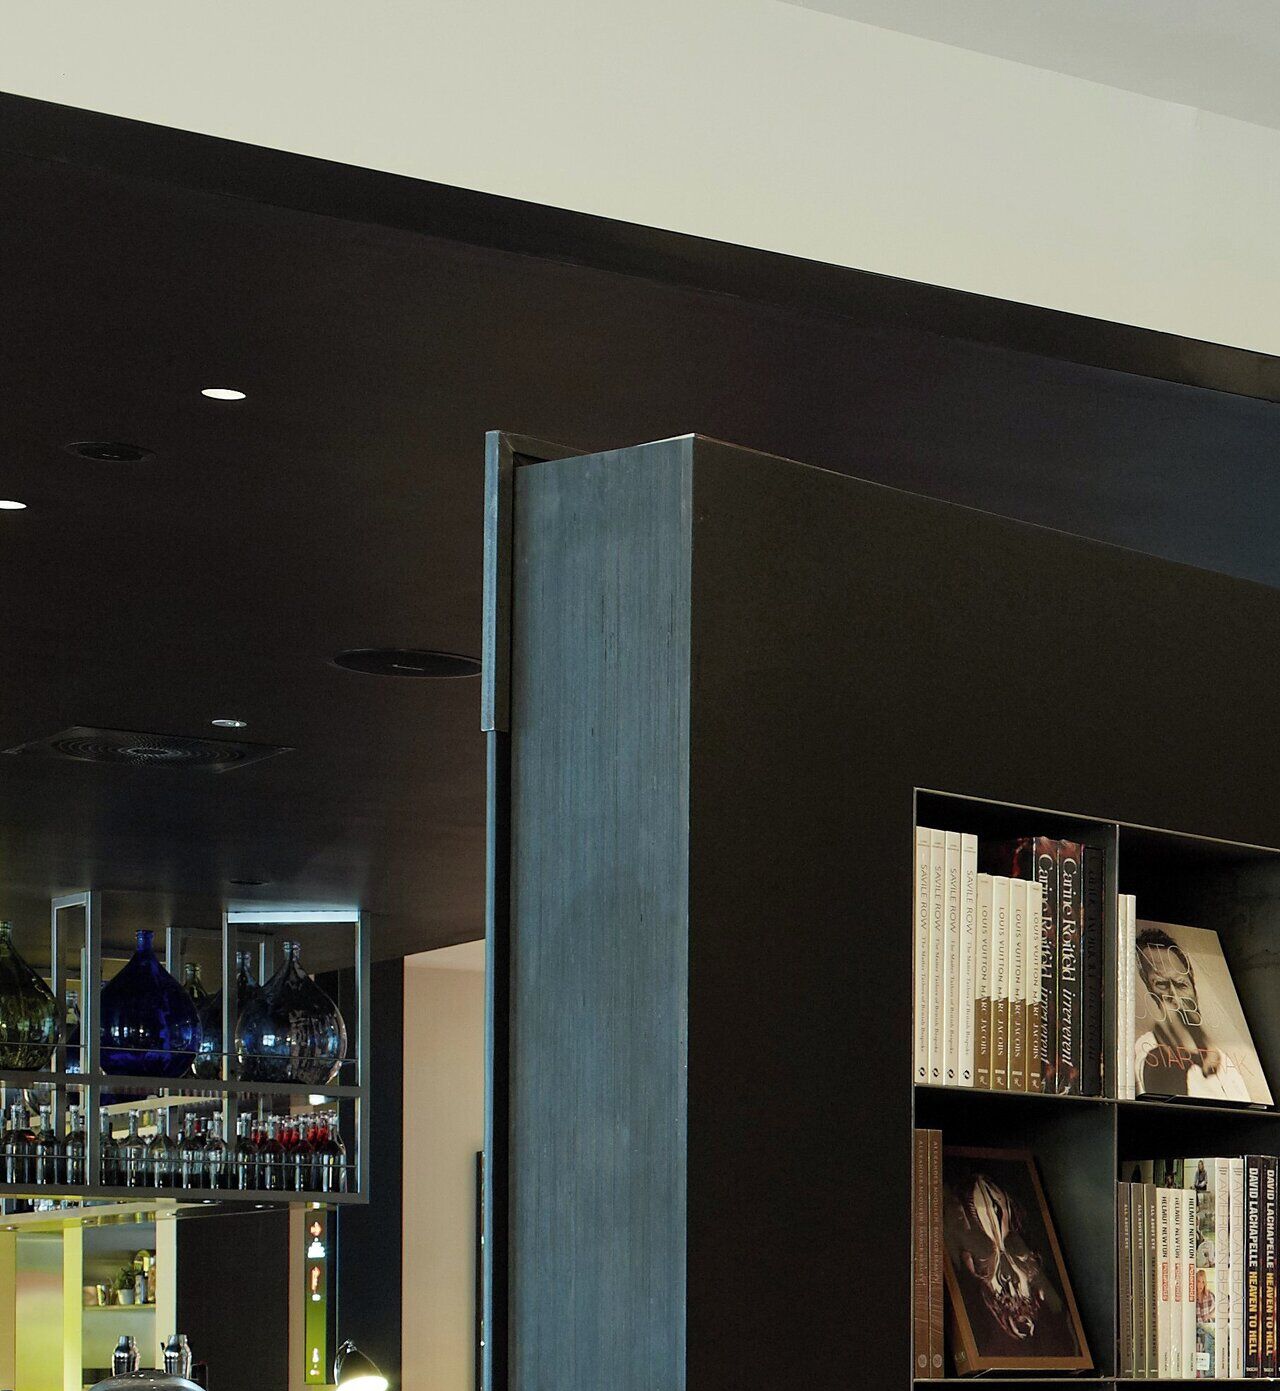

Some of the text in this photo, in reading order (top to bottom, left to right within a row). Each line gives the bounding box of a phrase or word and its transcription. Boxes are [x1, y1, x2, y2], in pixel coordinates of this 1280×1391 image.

[1061, 857, 1079, 1067] Carine Roitfeld irreverent
[1267, 1169, 1275, 1199] DAVID
[1267, 1202, 1275, 1268] LACHAPELLE
[1249, 1168, 1258, 1355] DAVID LACHAPELLE HEAVEN TO HELL
[1266, 1331, 1274, 1356] HELL
[1267, 1316, 1274, 1328] TO
